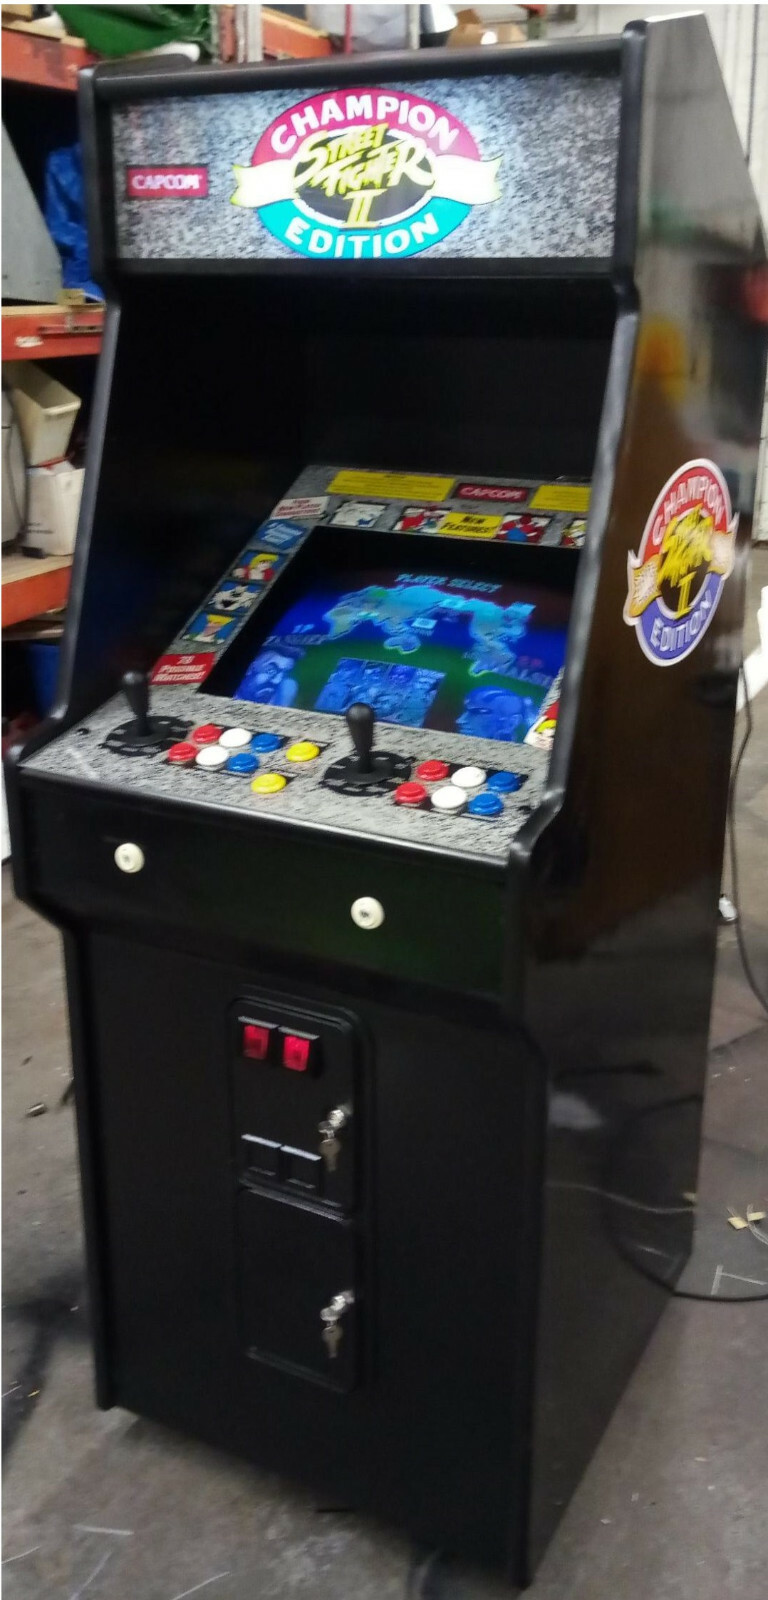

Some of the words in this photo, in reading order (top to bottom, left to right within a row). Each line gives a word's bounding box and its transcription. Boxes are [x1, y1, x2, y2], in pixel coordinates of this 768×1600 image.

[270, 94, 460, 155] CHAMPION
[131, 174, 203, 190] CAPCOM
[292, 122, 390, 189] STREET
[308, 137, 436, 198] FIGHTER
[284, 212, 440, 258] EDITION
[460, 486, 525, 499] CAPCOM
[651, 475, 725, 546] CHAMPION
[650, 590, 712, 652] EDITION
